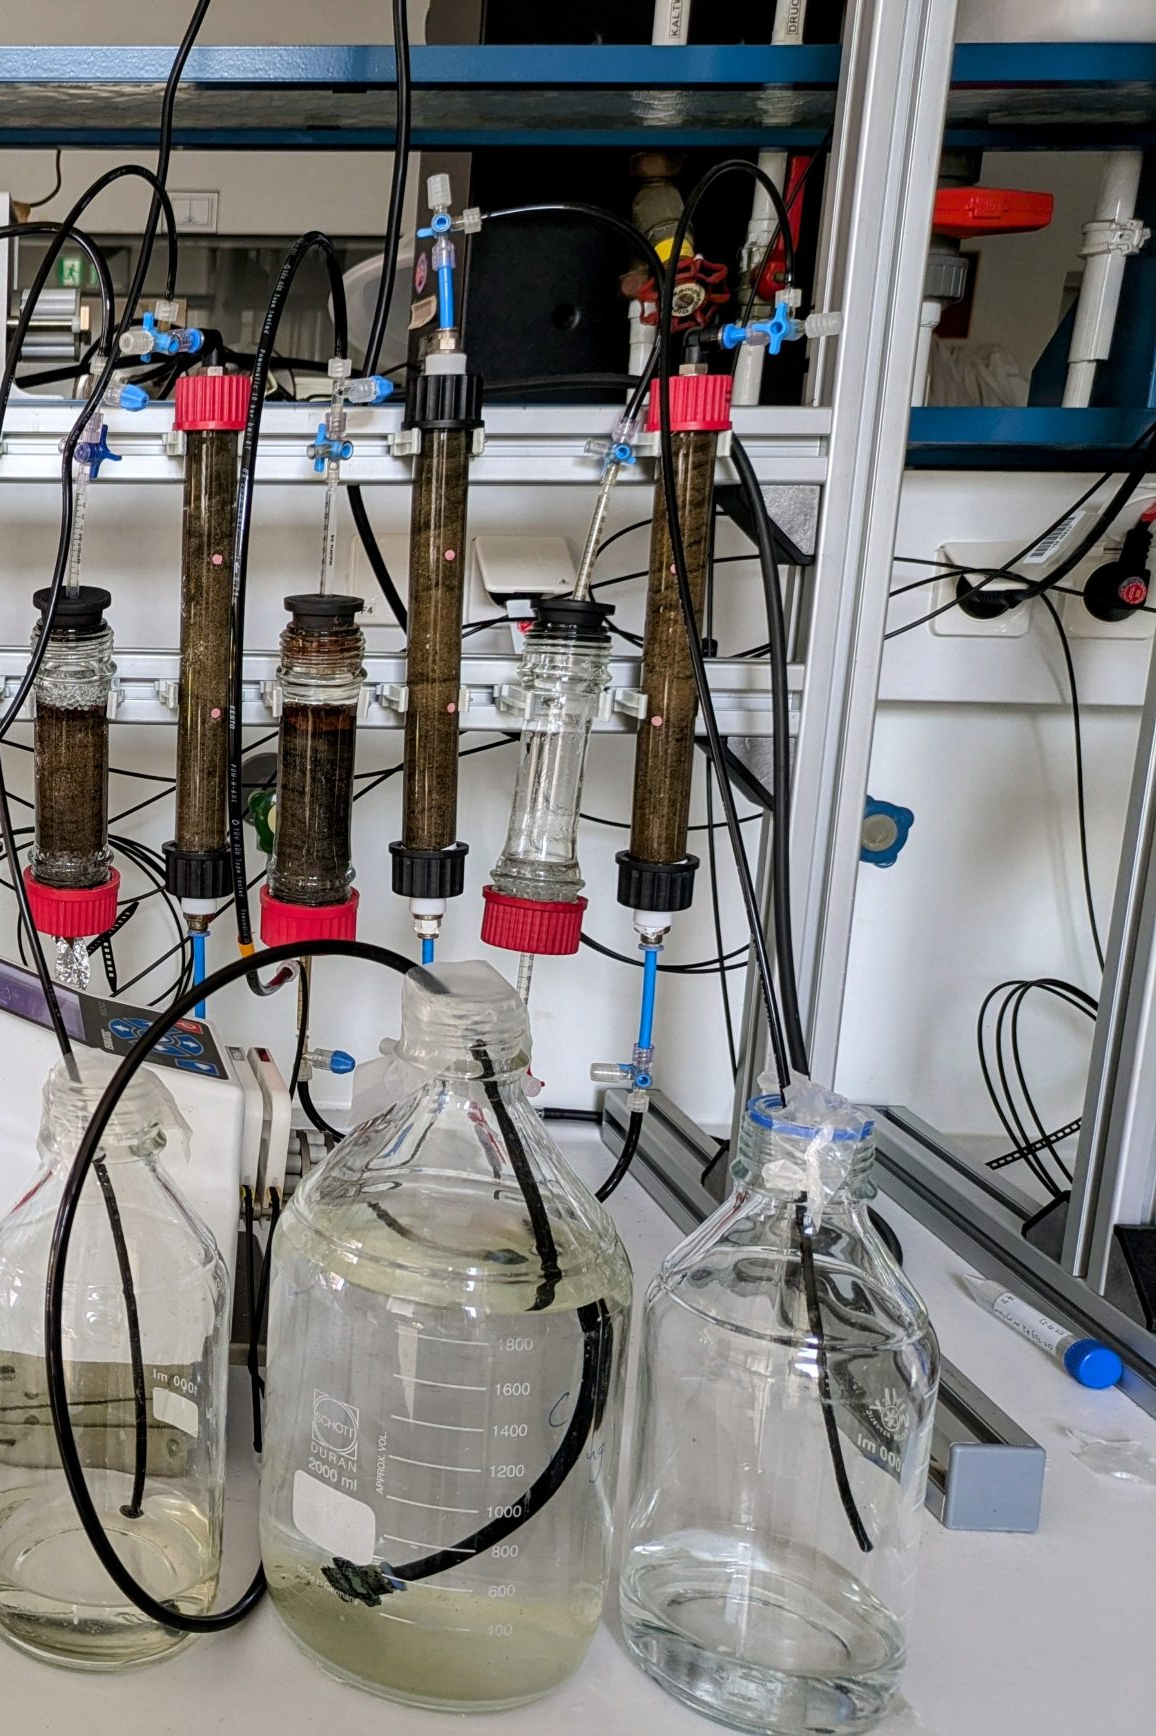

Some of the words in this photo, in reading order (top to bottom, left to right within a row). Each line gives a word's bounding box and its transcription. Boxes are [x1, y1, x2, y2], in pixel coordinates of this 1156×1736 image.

[498, 1337, 533, 1351] 1800
[495, 1382, 531, 1396] 1600
[315, 1411, 355, 1438] SCHOTT
[492, 1424, 528, 1437] 1400
[378, 1432, 388, 1453] VOL.
[310, 1441, 357, 1473] DURAN
[308, 1457, 338, 1482] 2000
[341, 1476, 357, 1491] ml
[376, 1454, 386, 1495] APPROX.
[489, 1464, 525, 1478] 1200
[487, 1505, 522, 1518] 1000
[491, 1545, 519, 1558] 800
[324, 1583, 360, 1606] Germany
[488, 1585, 516, 1598] 600
